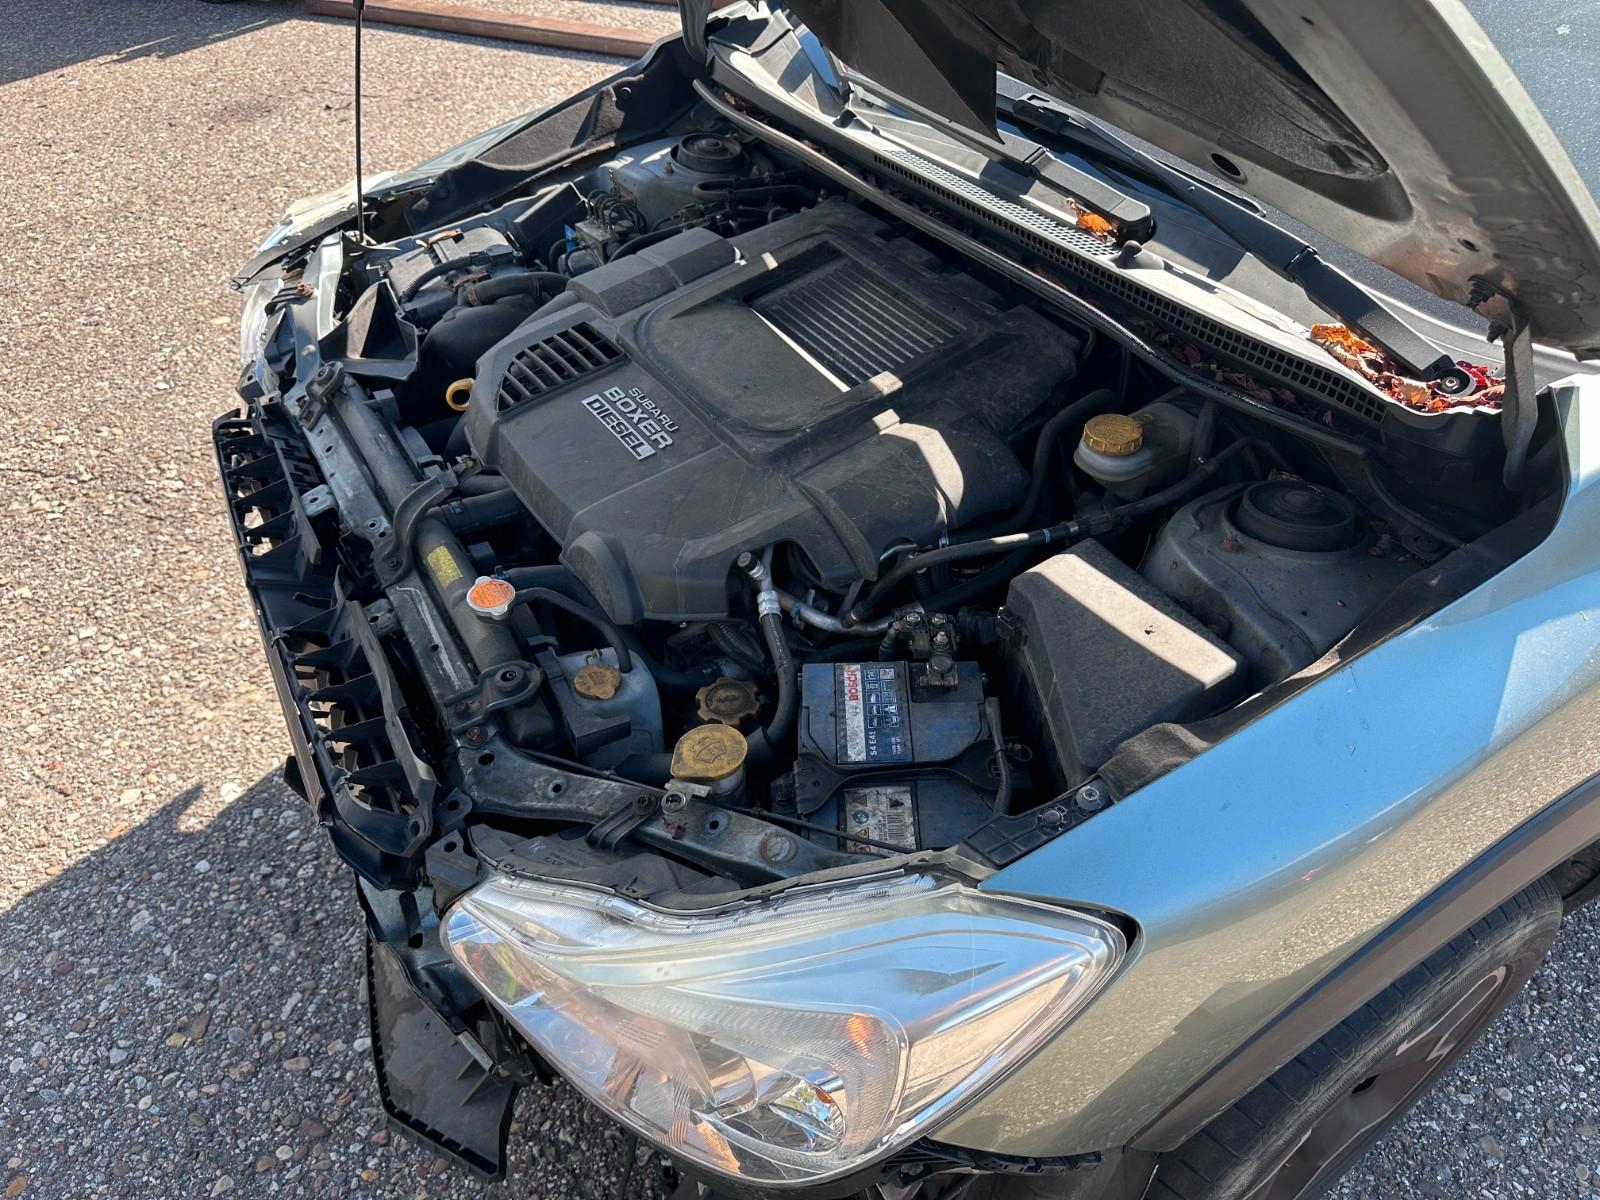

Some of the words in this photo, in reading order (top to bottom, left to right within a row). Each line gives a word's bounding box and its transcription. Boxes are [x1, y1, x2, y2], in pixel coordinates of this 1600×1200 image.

[584, 396, 648, 459] DIESEL
[603, 386, 673, 449] BOXER
[629, 387, 679, 432] SUBARU
[848, 670, 859, 701] BOSCH
[870, 746, 877, 755] S4
